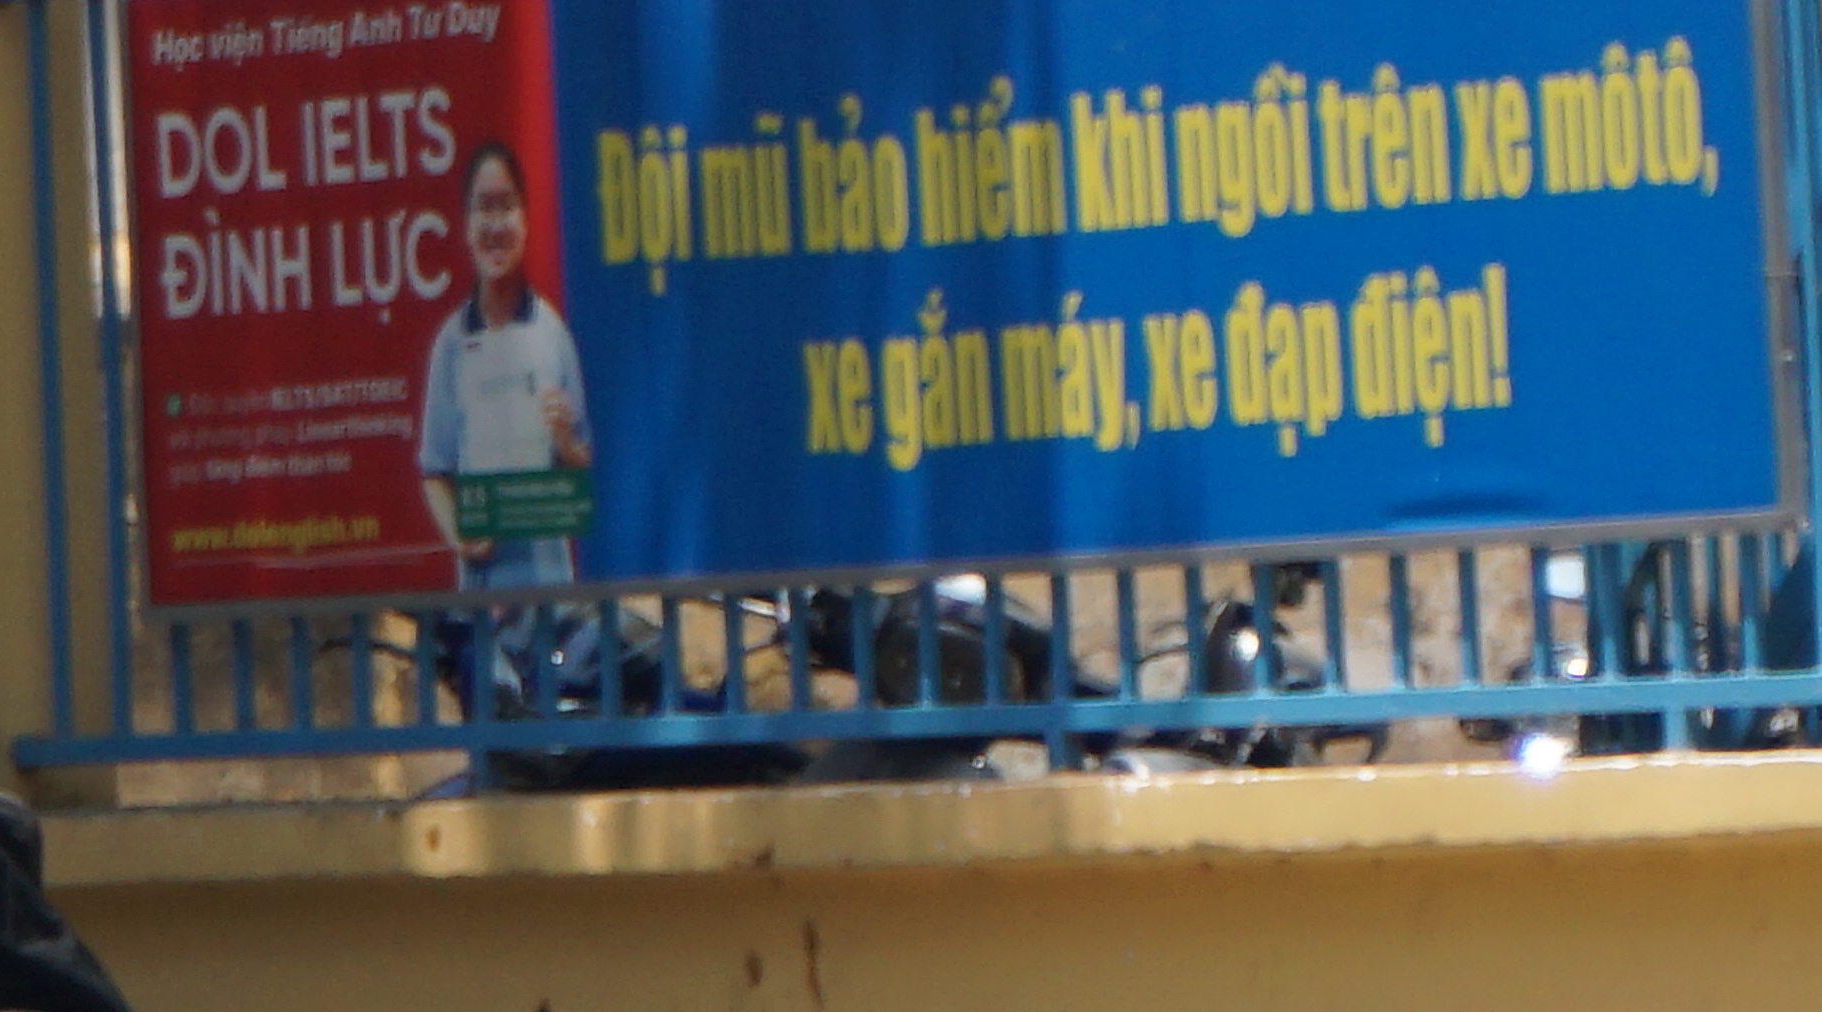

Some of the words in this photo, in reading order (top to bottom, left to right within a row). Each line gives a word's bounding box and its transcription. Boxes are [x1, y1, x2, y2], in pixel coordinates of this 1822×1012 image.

[152, 29, 203, 71] Học
[209, 21, 263, 66] viện
[270, 16, 343, 58] Tiếng
[350, 11, 402, 46] Anh
[408, 4, 444, 39] Tư
[447, 1, 500, 43] Duy
[156, 105, 287, 198] DOL
[301, 87, 456, 186] IELTS
[598, 125, 691, 296] Đội
[700, 112, 791, 259] mũ
[798, 93, 909, 253] bảo
[915, 75, 1067, 246] hiểm
[1070, 85, 1169, 232] khi
[1176, 62, 1312, 237] ngồi
[1317, 63, 1450, 212] trên
[1456, 76, 1533, 200] xe
[1539, 36, 1718, 197] môtô,
[161, 209, 311, 320] ĐÌNH
[331, 210, 452, 324] LỰC
[803, 337, 873, 455] xe
[882, 287, 993, 471] gắn
[1001, 290, 1140, 452] máy,
[1144, 309, 1217, 431] xe
[1225, 281, 1343, 457] đạp
[1351, 263, 1511, 447] điện!
[173, 516, 379, 555] www.dolenglish.vn
